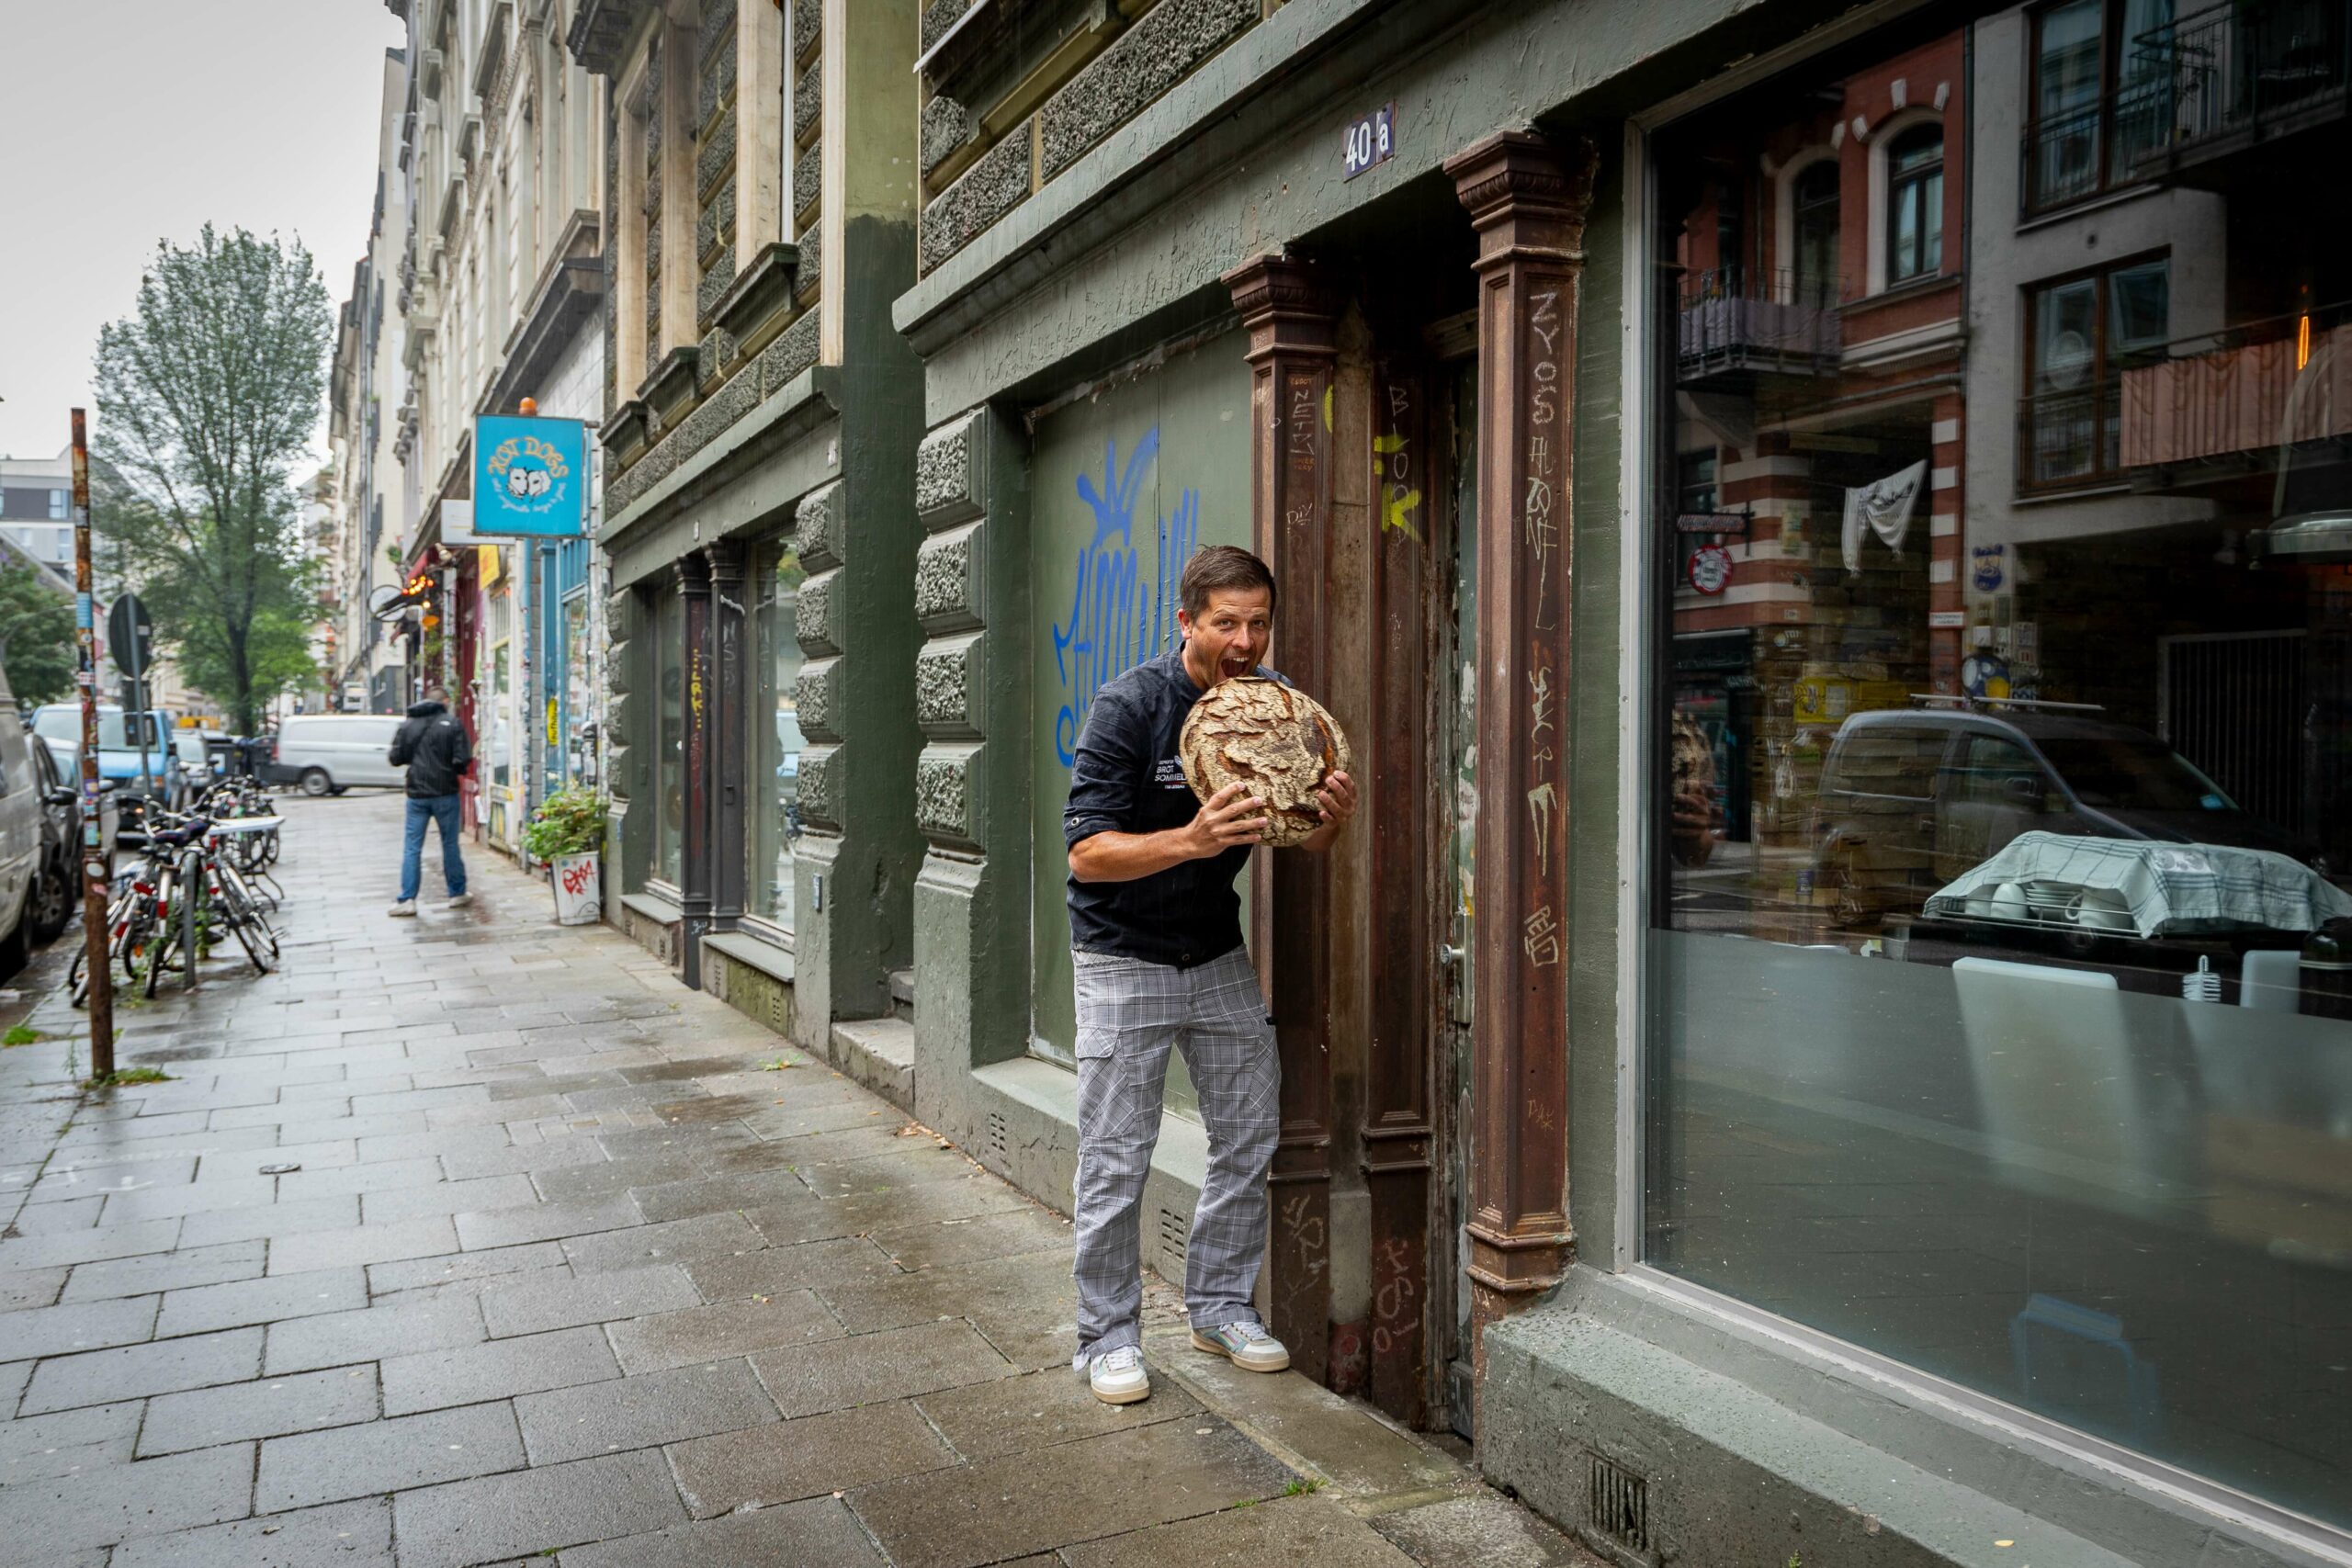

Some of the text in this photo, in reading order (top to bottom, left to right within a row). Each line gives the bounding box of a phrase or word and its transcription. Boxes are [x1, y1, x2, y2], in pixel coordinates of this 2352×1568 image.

[1345, 121, 1389, 172] 40 a
[487, 434, 570, 479] HOT DOGS
